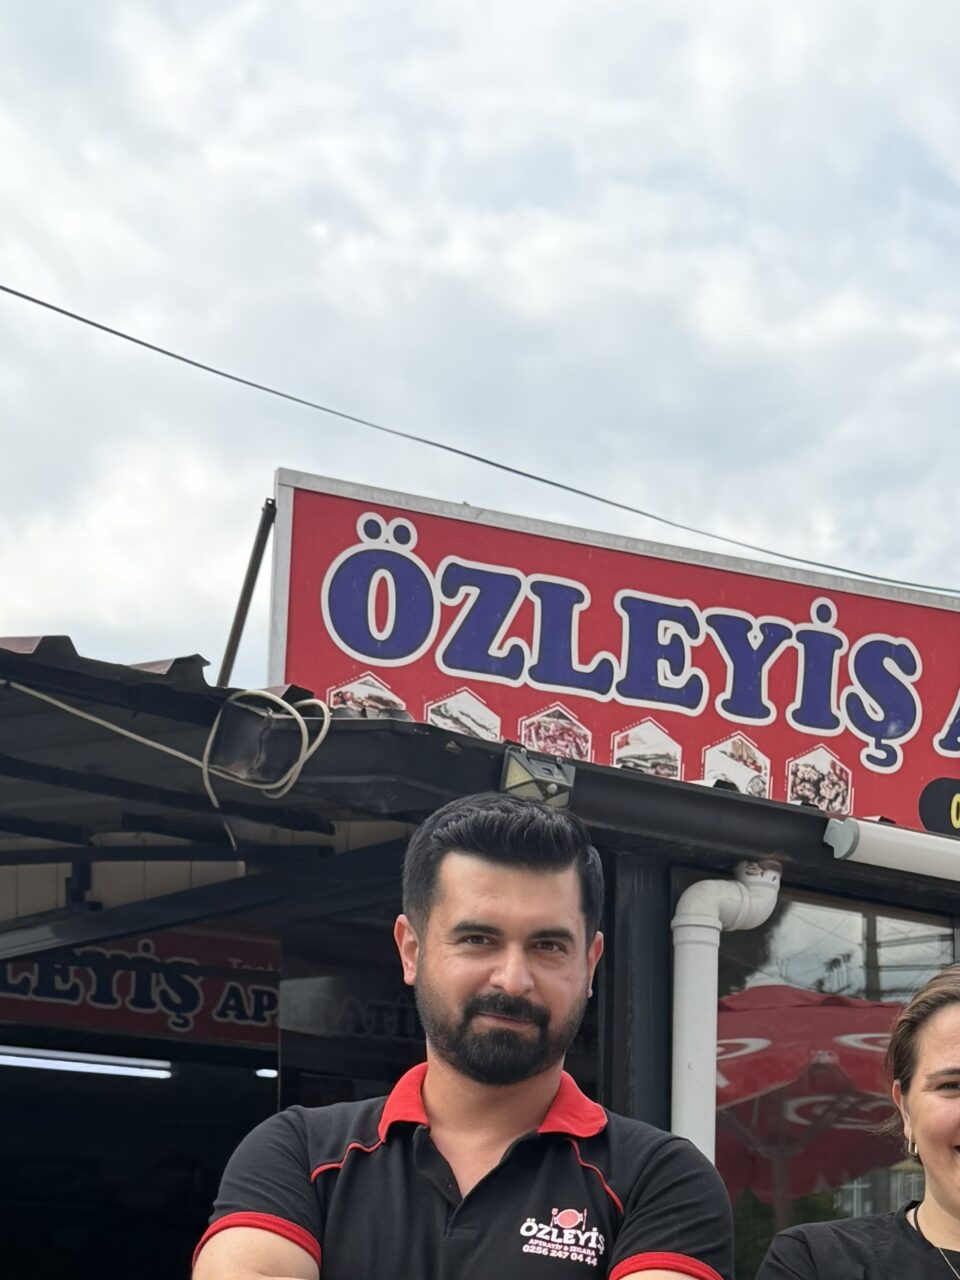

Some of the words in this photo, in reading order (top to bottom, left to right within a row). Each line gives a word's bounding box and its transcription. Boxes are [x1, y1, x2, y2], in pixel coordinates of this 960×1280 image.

[322, 512, 922, 773] ÖZLEYİŞ
[520, 1218, 605, 1255] ÖZLEYİŞ
[522, 1244, 549, 1255] 0256
[549, 1250, 569, 1259] 247
[570, 1253, 584, 1262] 04
[585, 1256, 597, 1266] 44
